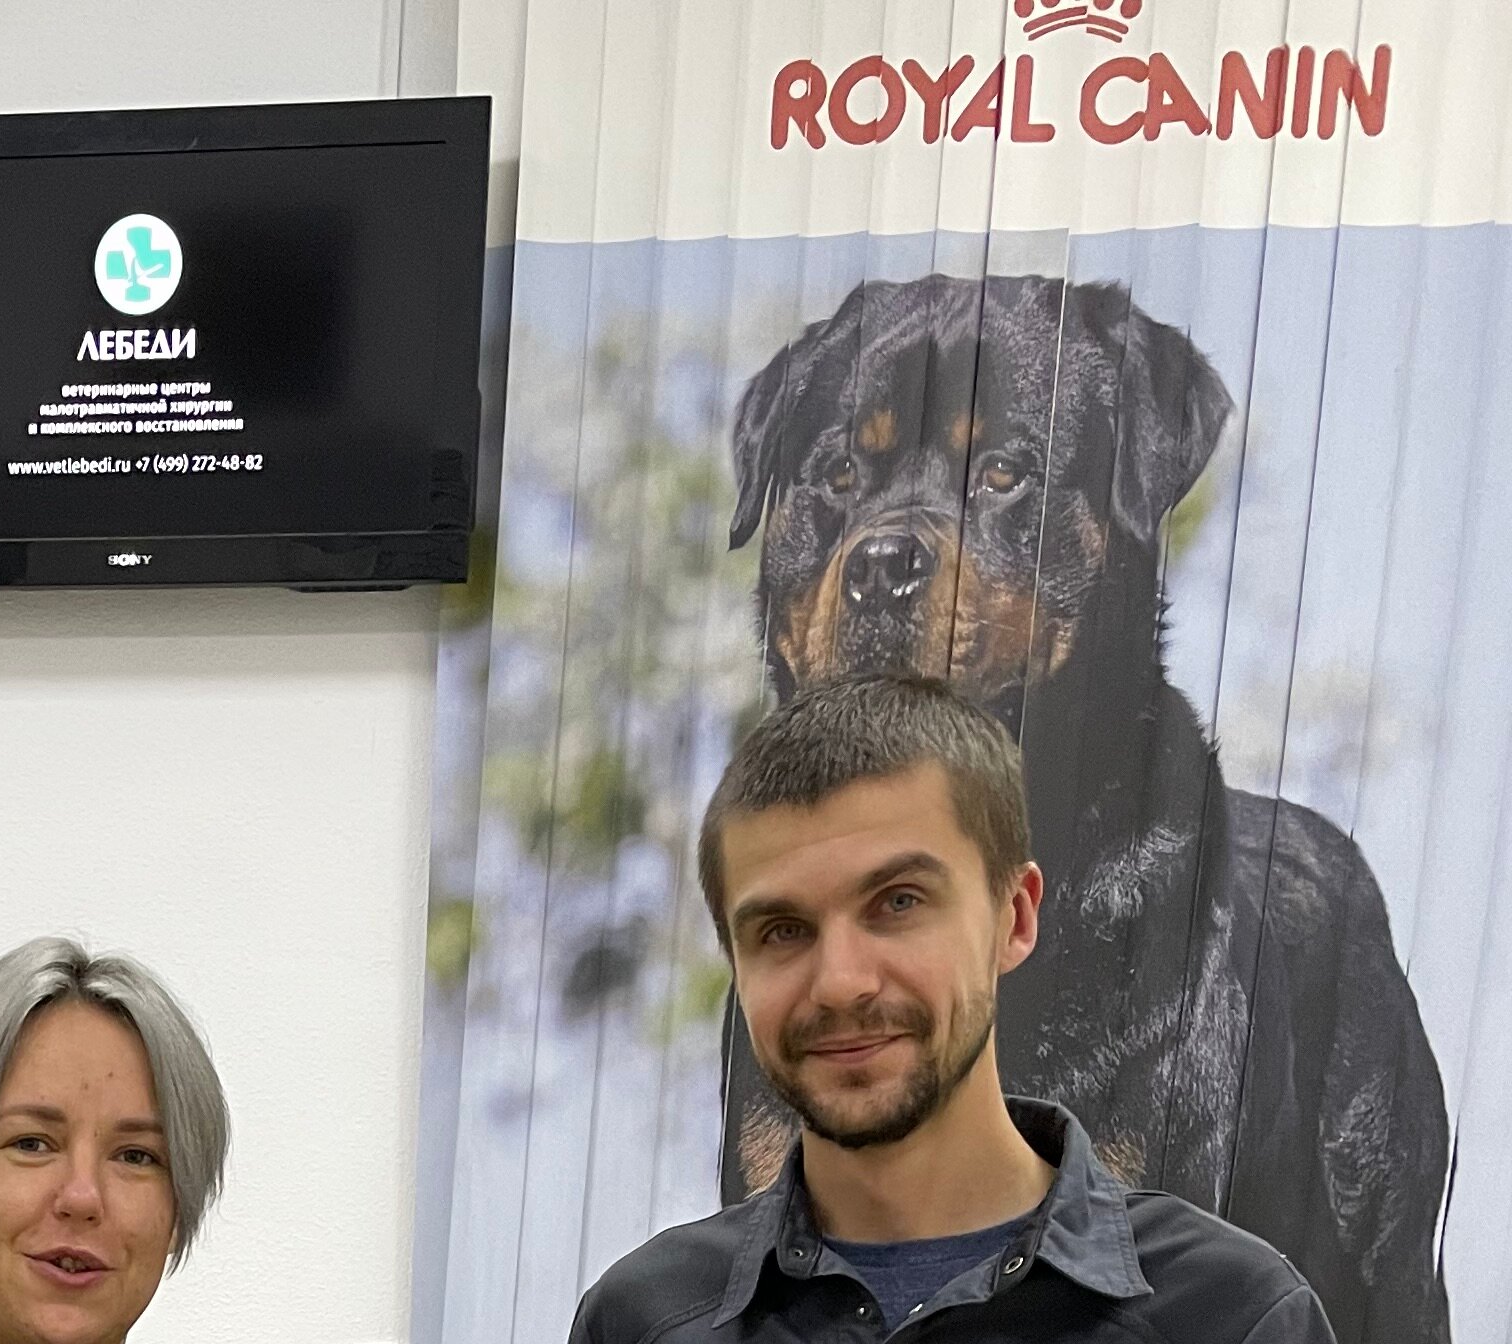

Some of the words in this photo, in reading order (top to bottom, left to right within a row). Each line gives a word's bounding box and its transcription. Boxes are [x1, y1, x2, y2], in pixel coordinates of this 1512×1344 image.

[771, 54, 1055, 150] ROYAL
[1080, 44, 1390, 144] CANIN
[77, 328, 195, 361] ЛЕБЕДИ
[62, 383, 158, 399] ветеринарные
[161, 382, 211, 397] центры
[40, 399, 167, 418] малотравматичной
[170, 400, 233, 415] хирургии
[40, 421, 132, 434] комплексного
[136, 419, 243, 433] восстановления
[8, 456, 130, 474] www.vetlebedi.ru
[136, 457, 150, 471] +7
[153, 454, 188, 473] (499)
[192, 455, 263, 471] 272-48-82
[108, 553, 153, 567] SONY
